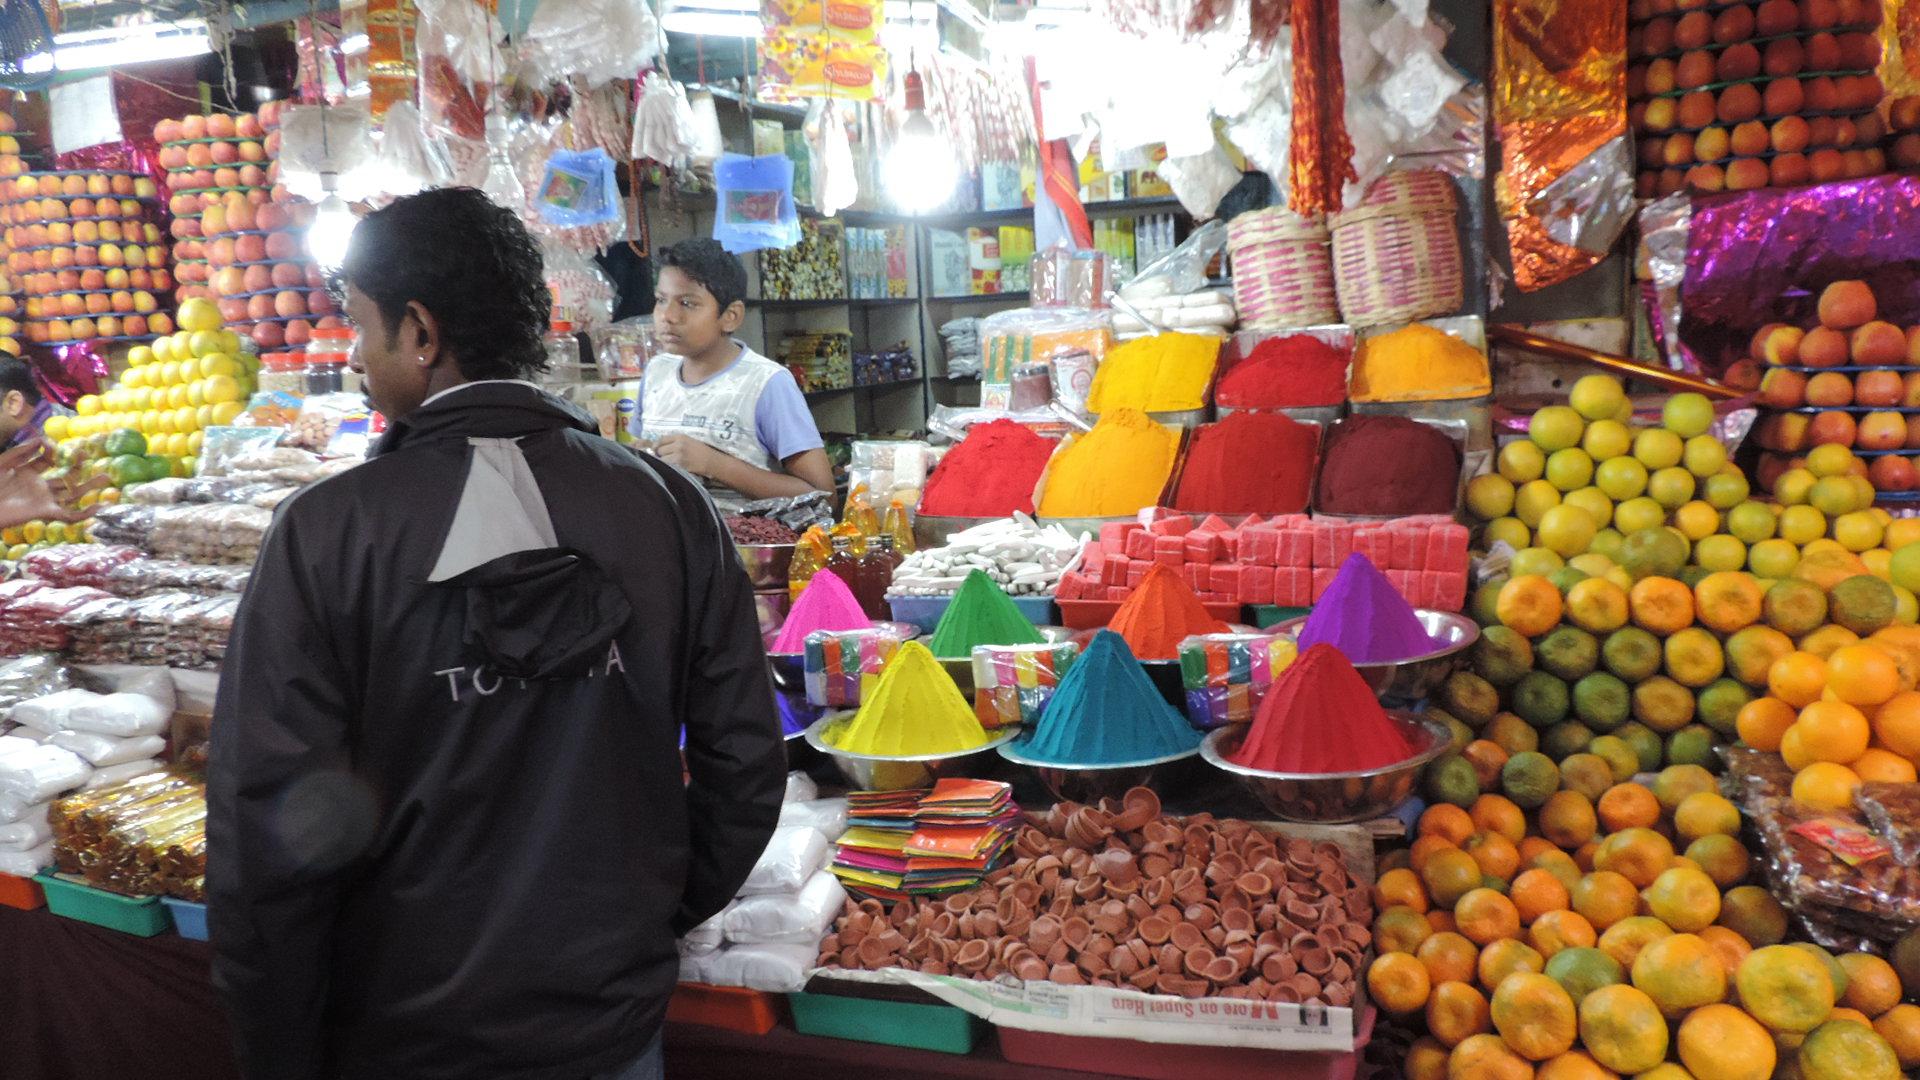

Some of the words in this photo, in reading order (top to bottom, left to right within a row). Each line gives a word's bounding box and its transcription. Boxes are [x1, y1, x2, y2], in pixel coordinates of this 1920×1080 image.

[720, 419, 734, 440] 3
[434, 639, 625, 701] TOA
[1112, 998, 1145, 1016] Hero
[1151, 999, 1194, 1017] Super
[1200, 1002, 1219, 1015] on
